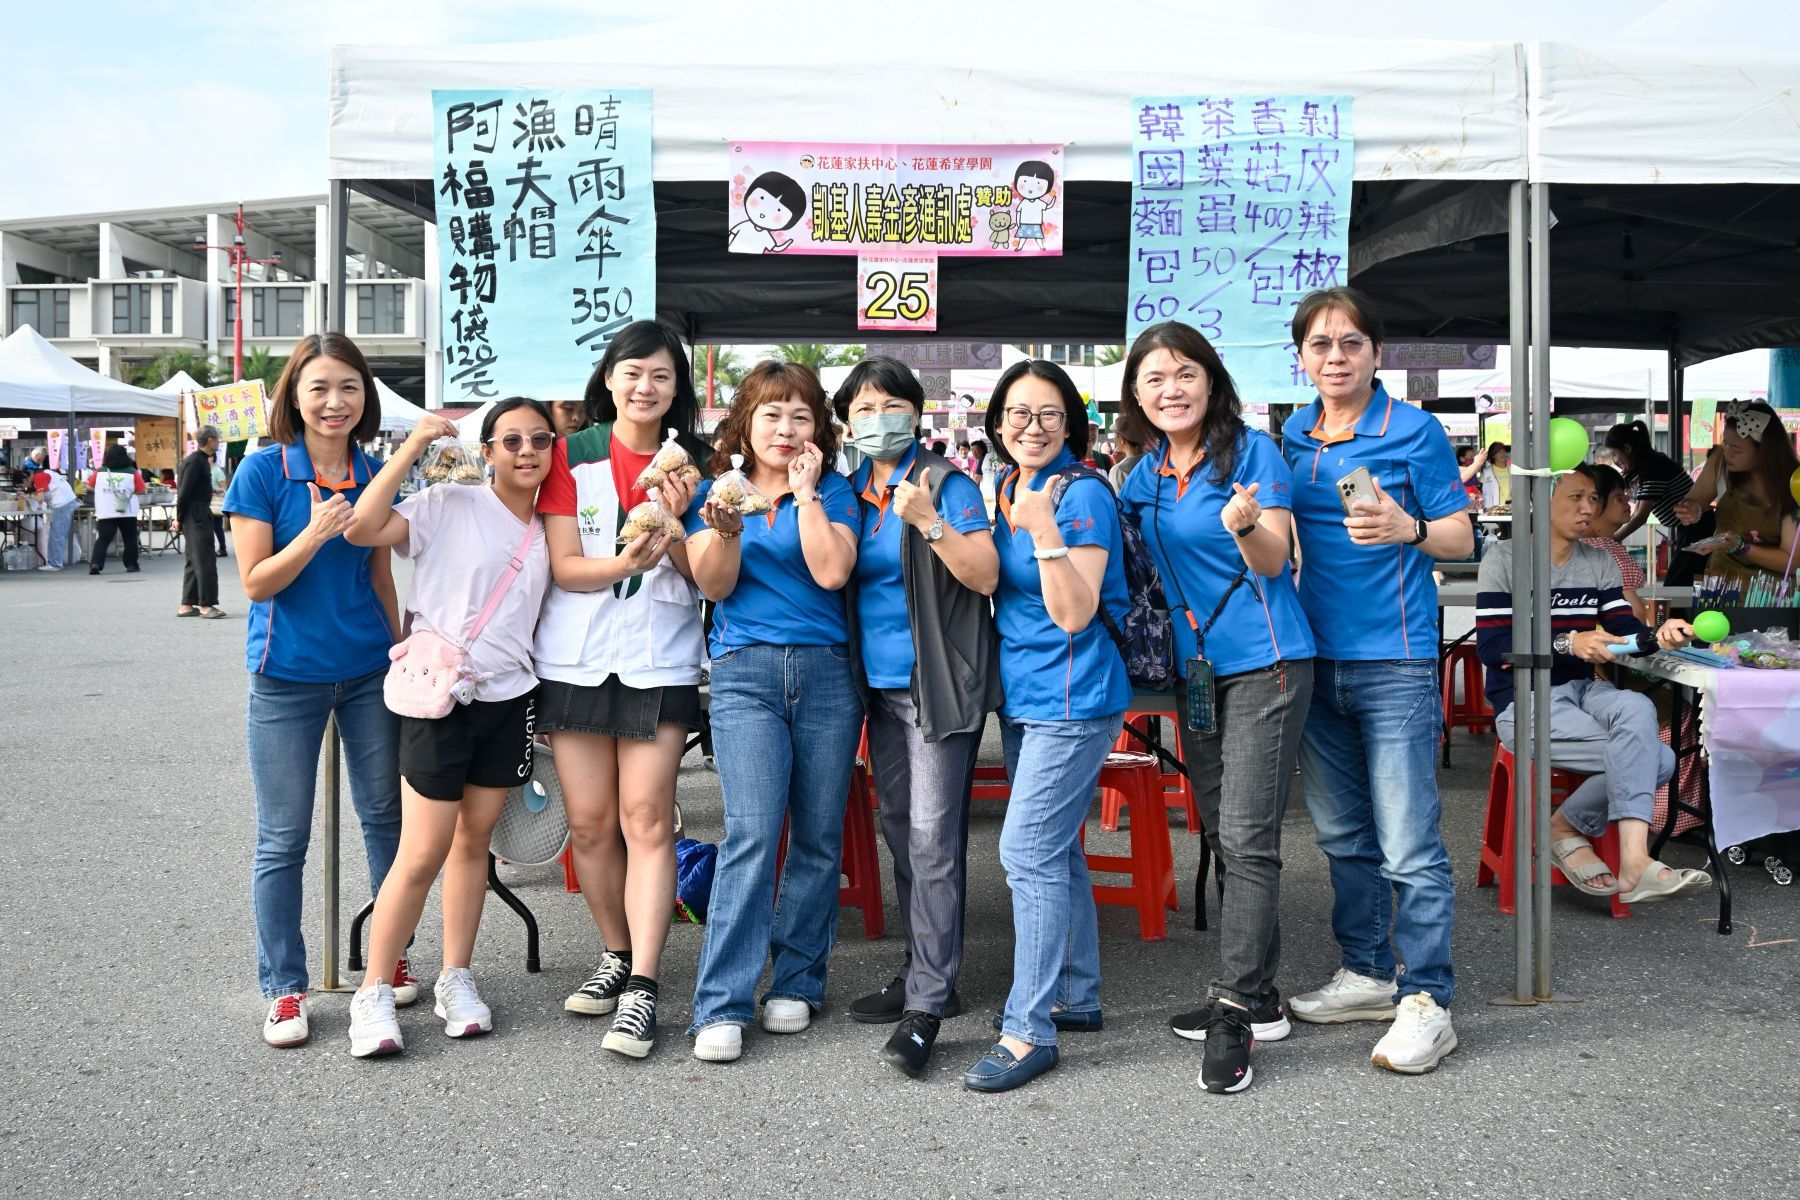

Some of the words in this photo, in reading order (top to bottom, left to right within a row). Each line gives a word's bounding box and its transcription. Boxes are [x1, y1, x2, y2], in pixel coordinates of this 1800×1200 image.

[503, 97, 566, 262] 漁夫帽
[567, 94, 631, 281] 晴雨傘
[812, 182, 973, 244] 凱基人壽金彥通訊處
[975, 185, 1012, 207] 贊助
[817, 156, 992, 171] 花蓮家扶中心、花蓮希望學園
[1195, 97, 1237, 235] 茶葉蛋
[865, 270, 930, 321] 25
